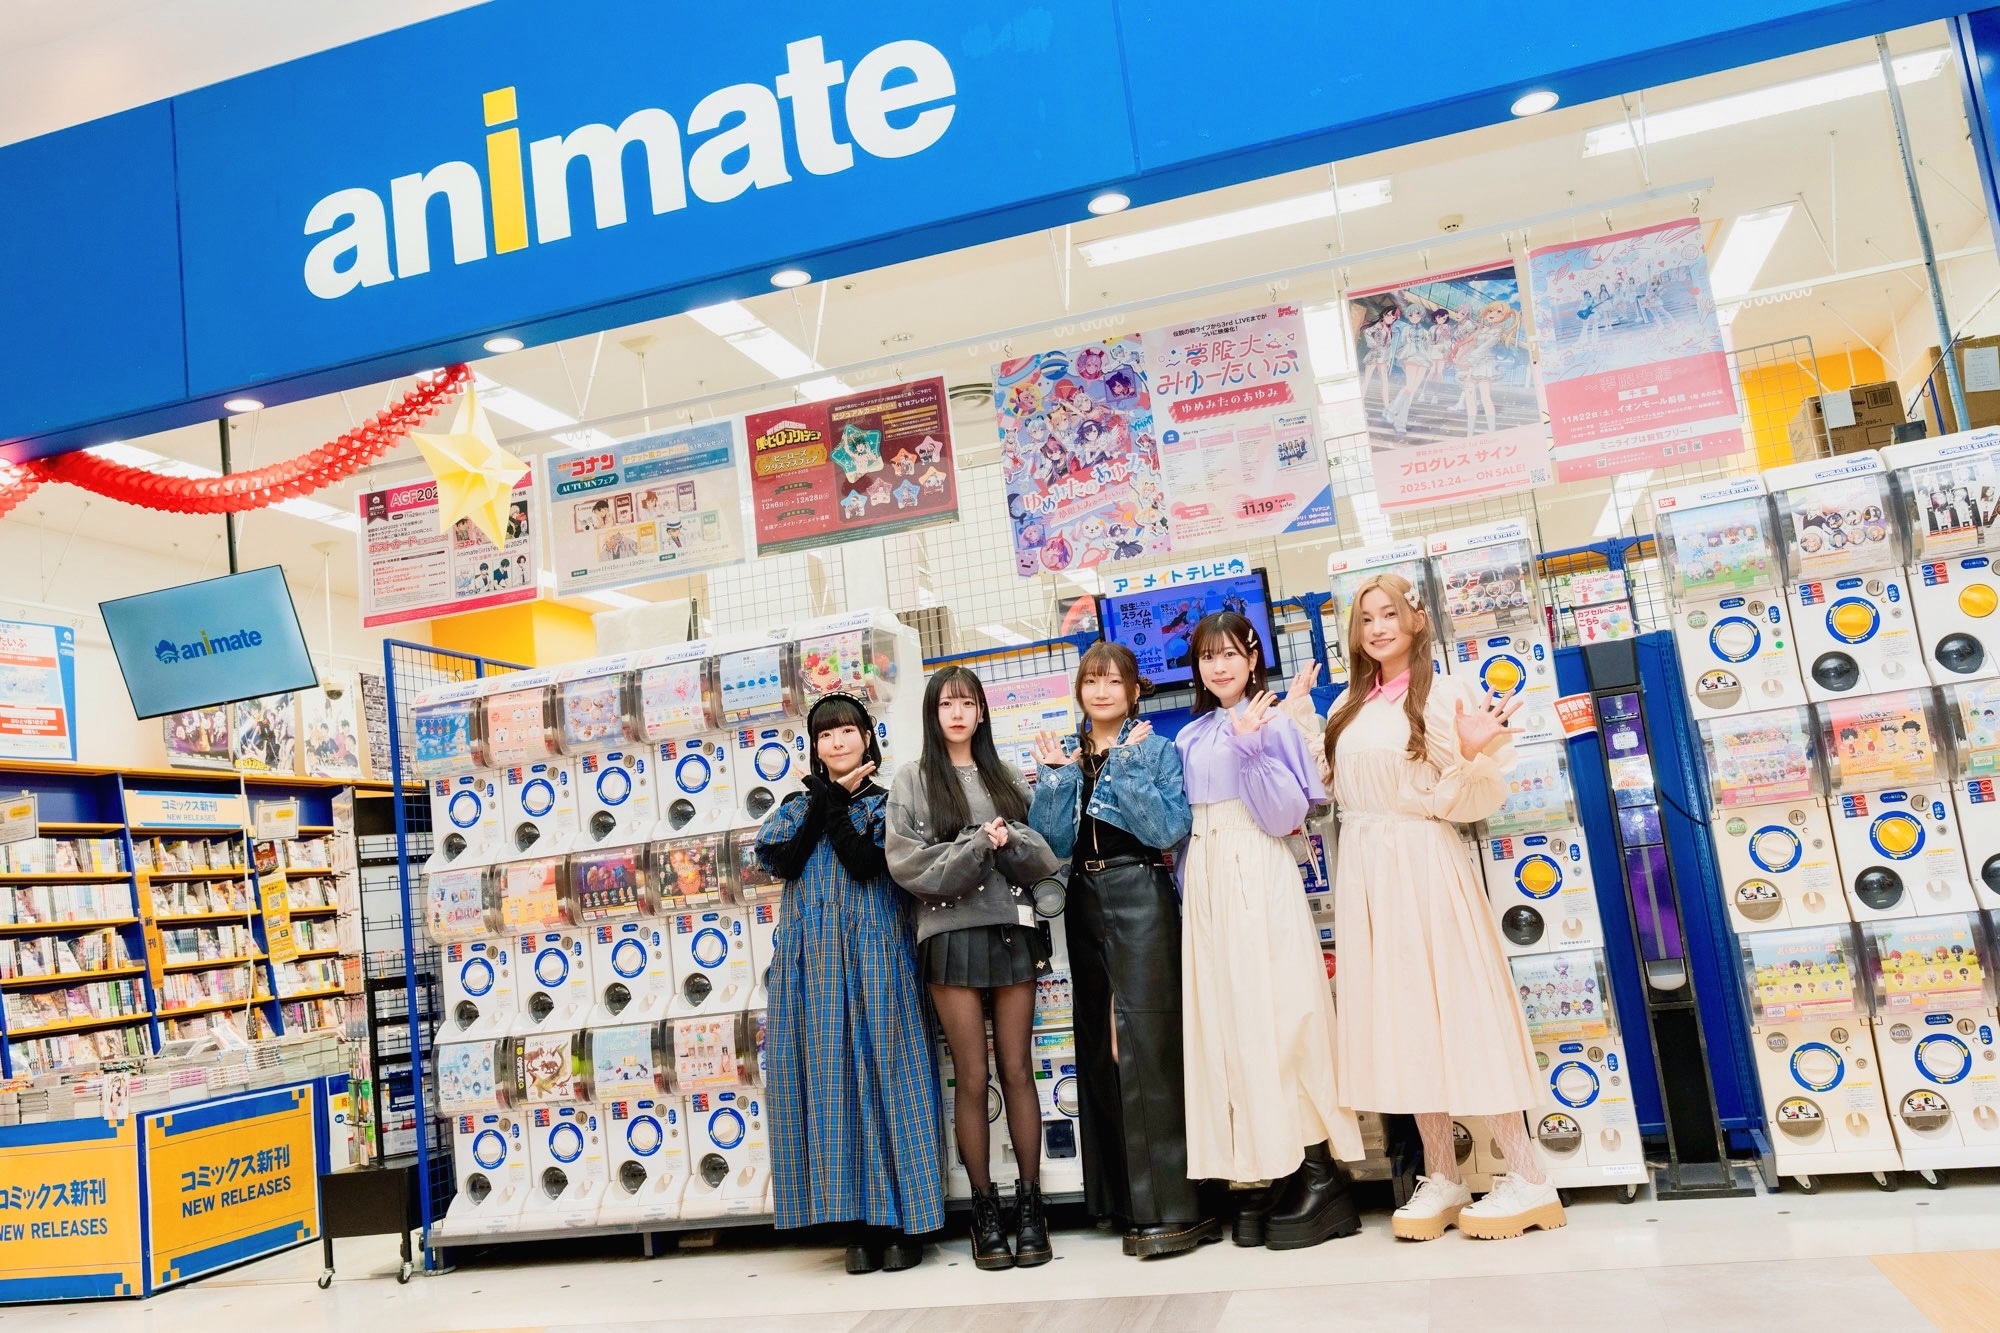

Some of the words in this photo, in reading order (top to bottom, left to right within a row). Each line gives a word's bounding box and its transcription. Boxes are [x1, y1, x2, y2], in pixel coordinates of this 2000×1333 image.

[303, 35, 957, 300] animate
[1173, 319, 1233, 337] 伝説の初ライブから3rd
[1185, 334, 1264, 366] 夢限大
[1156, 355, 1300, 396] みゅーたいぷ
[832, 405, 883, 420] ビジュアルカード
[1182, 389, 1278, 414] ゆめみたのあゆみ
[1562, 408, 1614, 424] 11月22日(土)
[1617, 394, 1686, 413] イオンモール船橋
[1600, 426, 1694, 450] ミニライブは観覧フリー!
[571, 453, 615, 476] コナン
[764, 456, 818, 472] クリスマスフェア
[773, 448, 807, 463] ヒーローズ
[1400, 453, 1470, 477] プログレス
[1474, 444, 1518, 463] サイン
[1476, 470, 1493, 481] ON
[1496, 464, 1526, 477] SALE!
[1023, 455, 1145, 514] ゆめみたのあゆみ
[390, 486, 438, 508] AGF202
[1242, 501, 1274, 516] 11.19
[1574, 584, 1593, 594] こちら
[1120, 600, 1150, 612] 転生したら
[1121, 609, 1152, 620] スライム
[1577, 604, 1627, 619] カプセルのごみは
[1123, 618, 1153, 629] だった件
[1579, 616, 1600, 627] こちら
[181, 629, 263, 662] animate
[162, 800, 218, 812] コミックス新刊
[144, 915, 157, 948] 新刊
[1768, 1038, 1787, 1047] ¥400
[1891, 1029, 1911, 1037] ¥400
[181, 1143, 291, 1193] コミックス新刊
[0, 1177, 107, 1210] コミックス新刊
[181, 1196, 215, 1218] NEW
[221, 1175, 292, 1208] RELEASES
[31, 1217, 108, 1239] RELEASES
